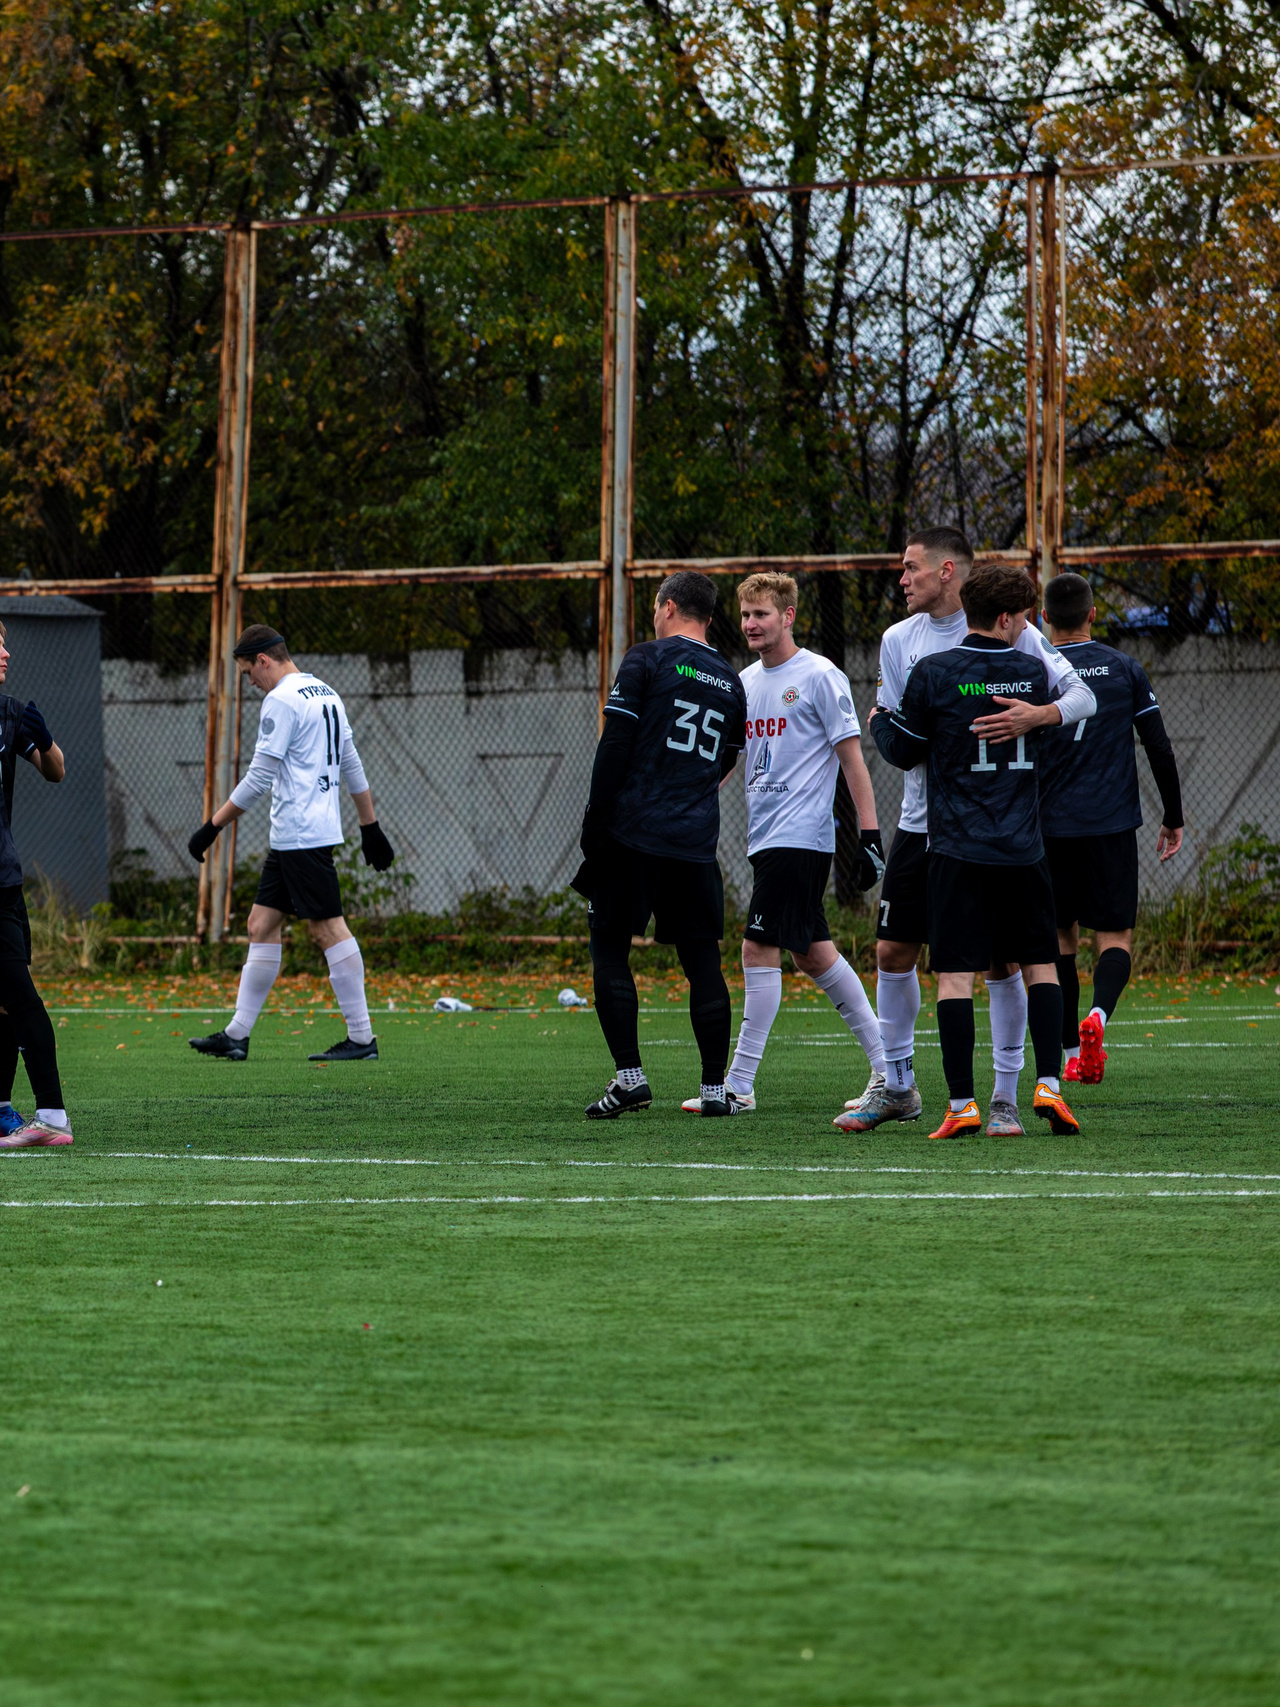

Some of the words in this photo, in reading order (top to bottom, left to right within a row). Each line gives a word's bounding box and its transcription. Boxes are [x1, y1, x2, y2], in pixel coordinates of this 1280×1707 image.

[676, 665, 732, 693] VINSERVICE
[958, 681, 1033, 696] VINSERVICE
[322, 704, 340, 766] 11
[666, 698, 725, 762] 35
[745, 717, 787, 740] СССР
[880, 899, 891, 927] 7
